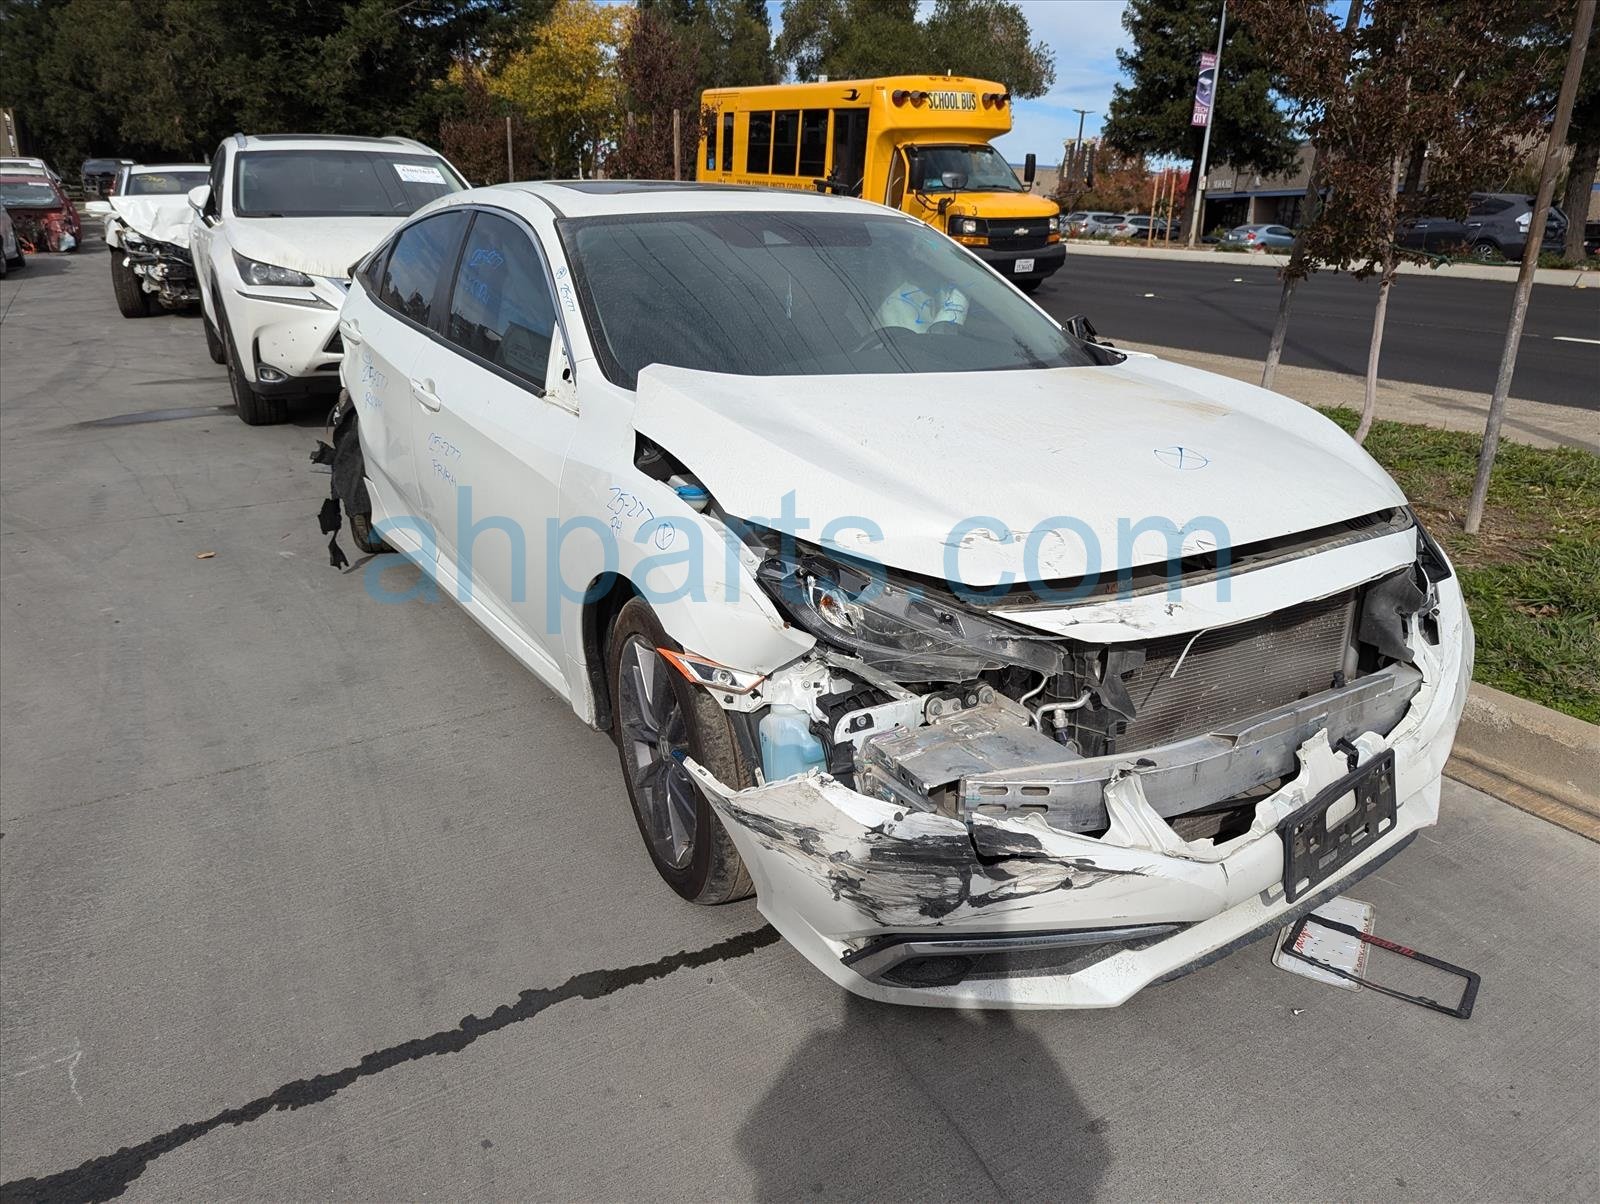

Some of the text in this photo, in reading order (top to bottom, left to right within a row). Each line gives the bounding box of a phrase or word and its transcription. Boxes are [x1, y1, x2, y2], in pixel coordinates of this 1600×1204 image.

[928, 92, 976, 110] SCHOOL BUS
[1193, 113, 1208, 124] CITY
